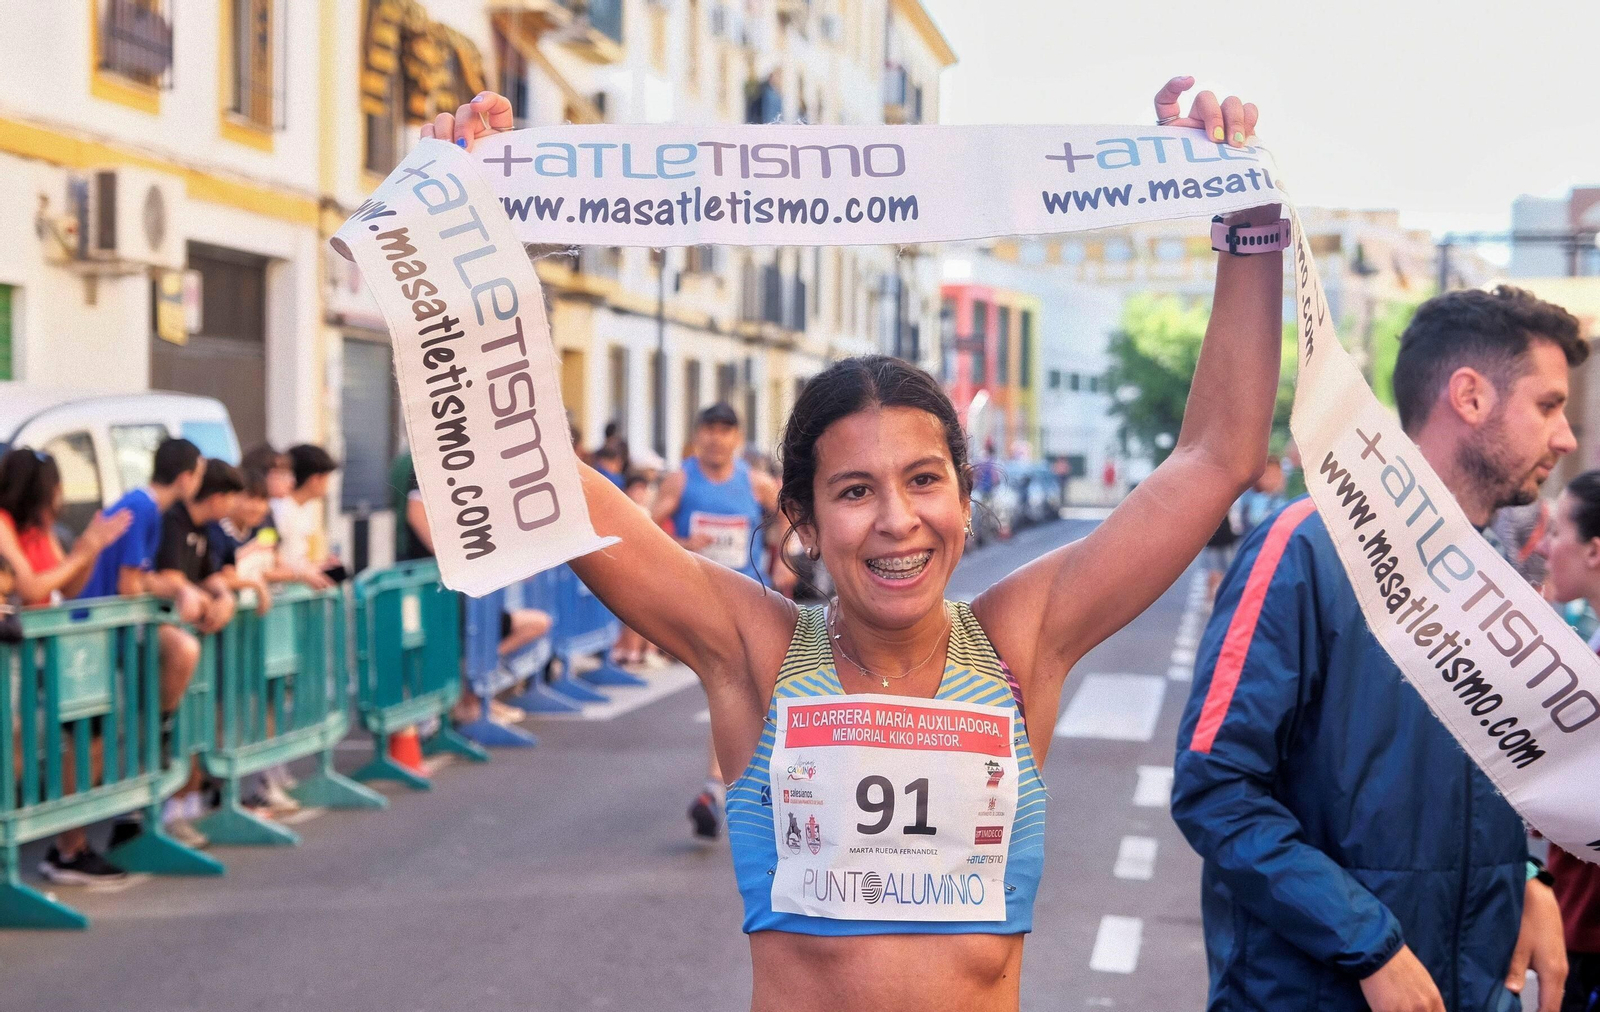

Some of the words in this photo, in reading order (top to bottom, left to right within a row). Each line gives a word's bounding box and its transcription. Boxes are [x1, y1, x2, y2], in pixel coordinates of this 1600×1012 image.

[499, 187, 919, 226] ww.masatletismo.com
[1319, 451, 1546, 770] www.masatletismo.com
[791, 712, 809, 728] XLI
[812, 709, 872, 727] CARRERA
[875, 708, 915, 729] MARÍA
[918, 714, 1003, 738] AUXILIADORA.
[832, 727, 887, 743] MEMORIAL
[889, 730, 914, 745] KIKO
[917, 733, 962, 747] PASTOR.
[790, 788, 813, 799] salesianos
[855, 774, 937, 836] 91
[875, 847, 898, 855] RUEDA
[899, 848, 938, 856] FERNANDEZ
